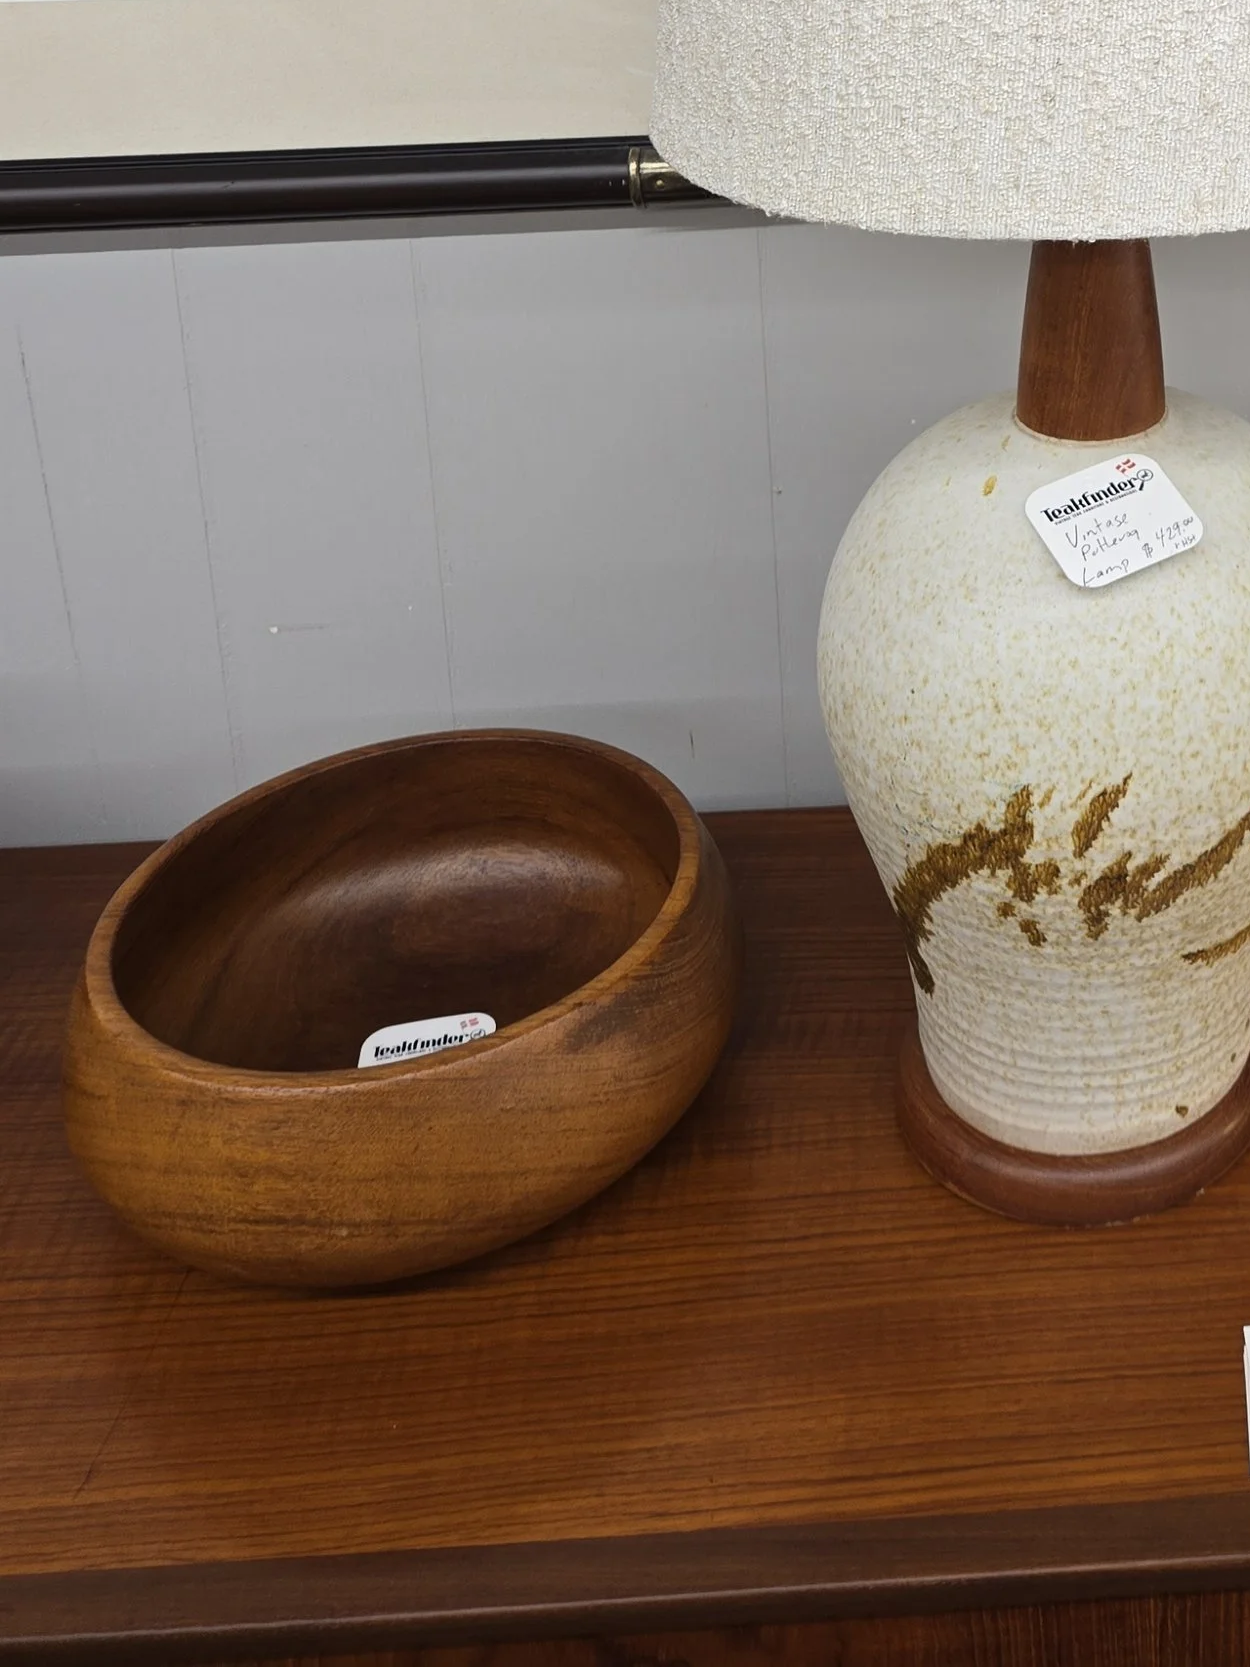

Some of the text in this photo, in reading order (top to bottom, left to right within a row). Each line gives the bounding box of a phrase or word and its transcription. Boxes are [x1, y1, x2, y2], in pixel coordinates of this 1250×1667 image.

[1040, 477, 1138, 522] Teakfinder
[1083, 558, 1129, 587] Lamp
[374, 1034, 469, 1058] Teakfinder
